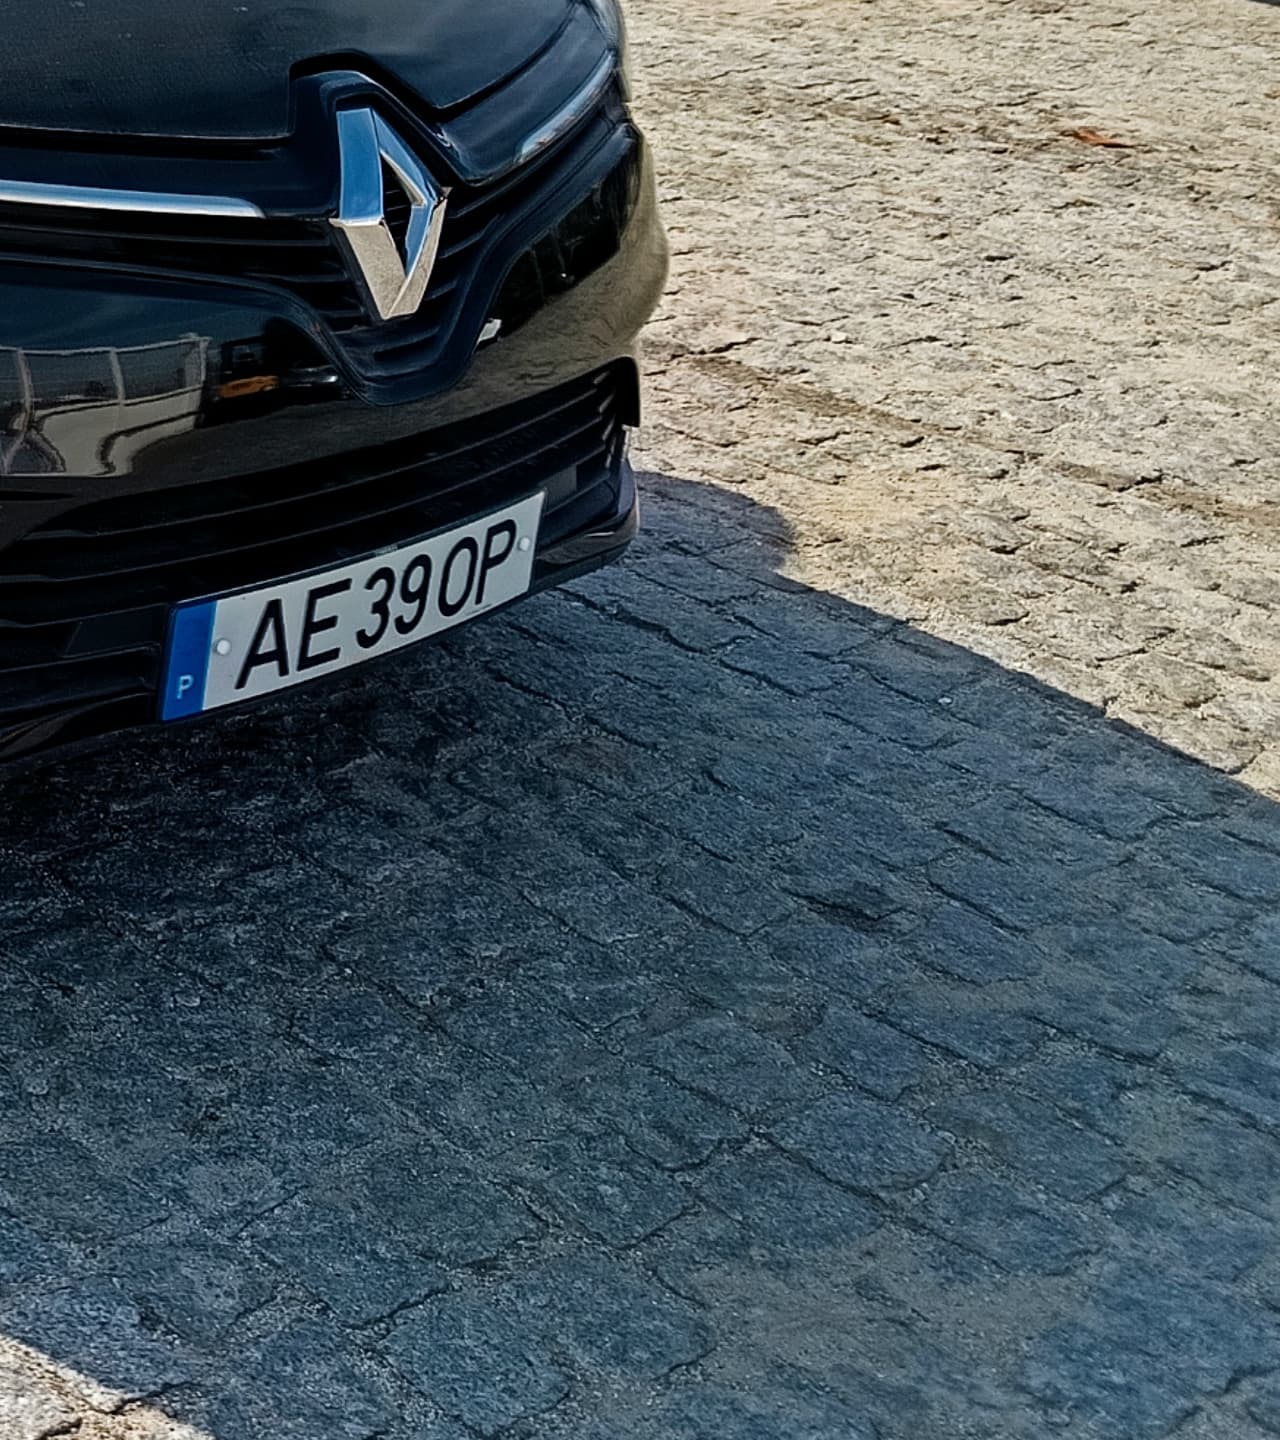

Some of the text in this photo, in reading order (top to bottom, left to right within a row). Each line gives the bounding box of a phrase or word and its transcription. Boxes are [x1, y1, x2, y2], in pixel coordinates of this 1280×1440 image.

[234, 518, 517, 690] AE 39 OP
[175, 673, 194, 700] P
